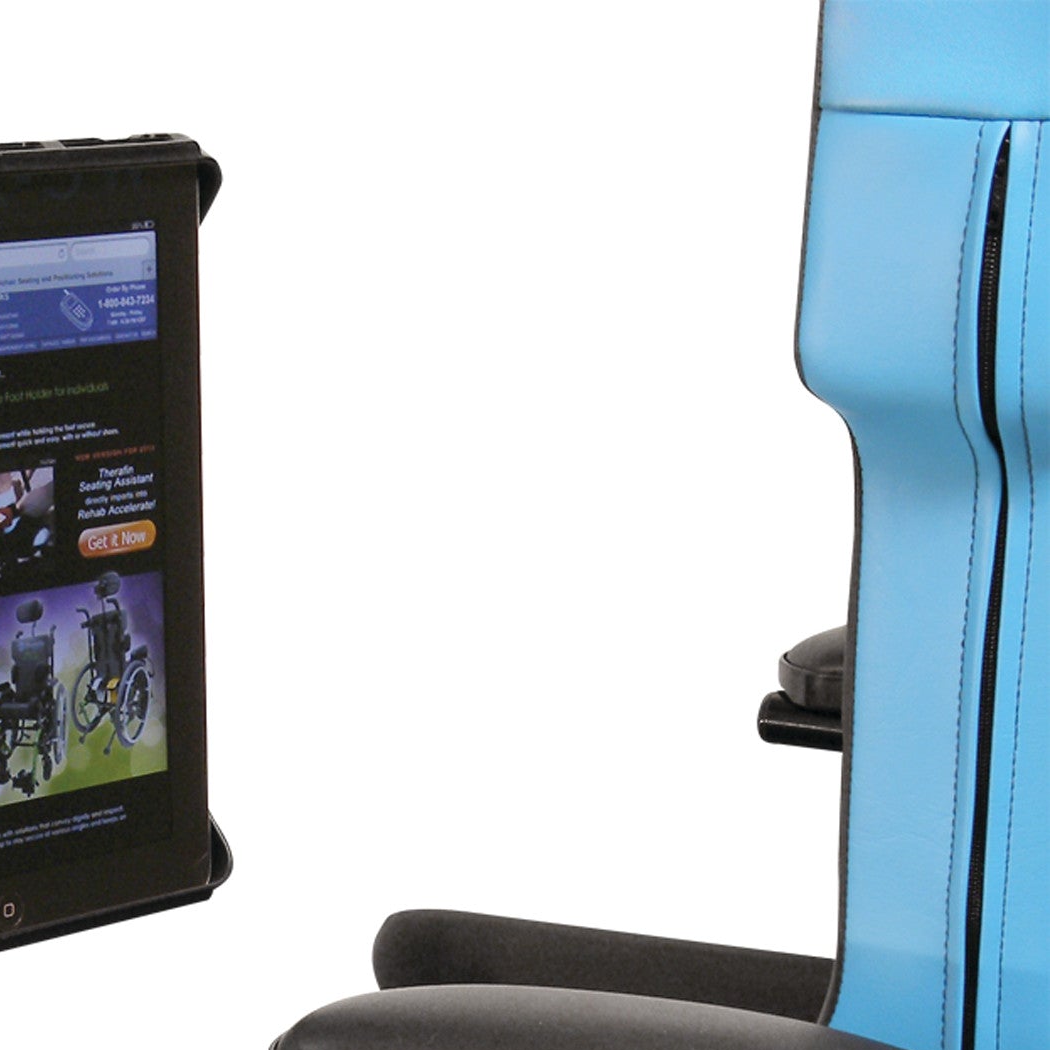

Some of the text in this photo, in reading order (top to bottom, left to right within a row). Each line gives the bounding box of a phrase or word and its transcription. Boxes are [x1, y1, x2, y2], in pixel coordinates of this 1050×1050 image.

[18, 276, 40, 285] Seating
[53, 272, 86, 282] Positioning
[86, 270, 113, 278] Solutions
[98, 464, 135, 479] Therafin
[78, 472, 154, 493] Seating Assistant
[77, 506, 107, 520] Rehab
[87, 530, 147, 550] Get it Now
